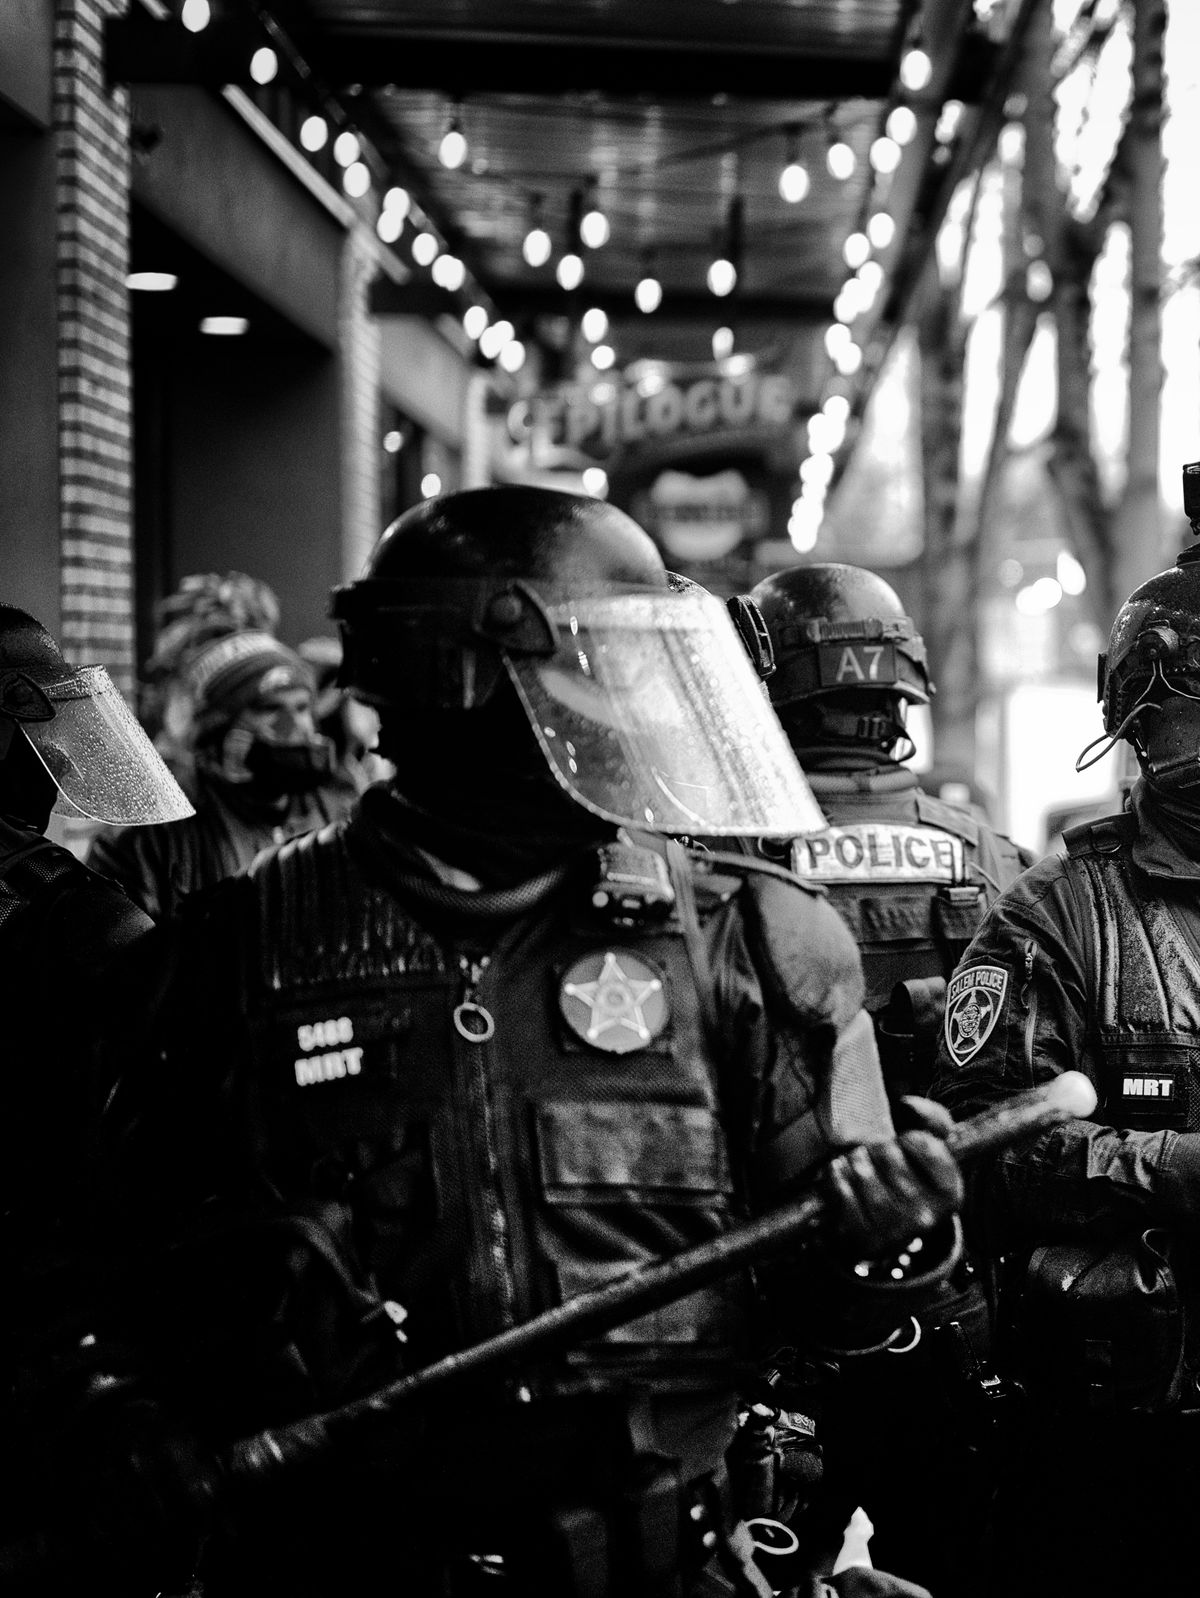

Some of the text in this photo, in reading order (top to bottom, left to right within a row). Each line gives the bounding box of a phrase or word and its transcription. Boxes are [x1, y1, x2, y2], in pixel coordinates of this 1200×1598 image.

[836, 646, 885, 682] A7
[804, 833, 954, 870] POLICE
[951, 970, 1004, 999] SALEM POLICE
[1122, 1078, 1173, 1097] MRT
